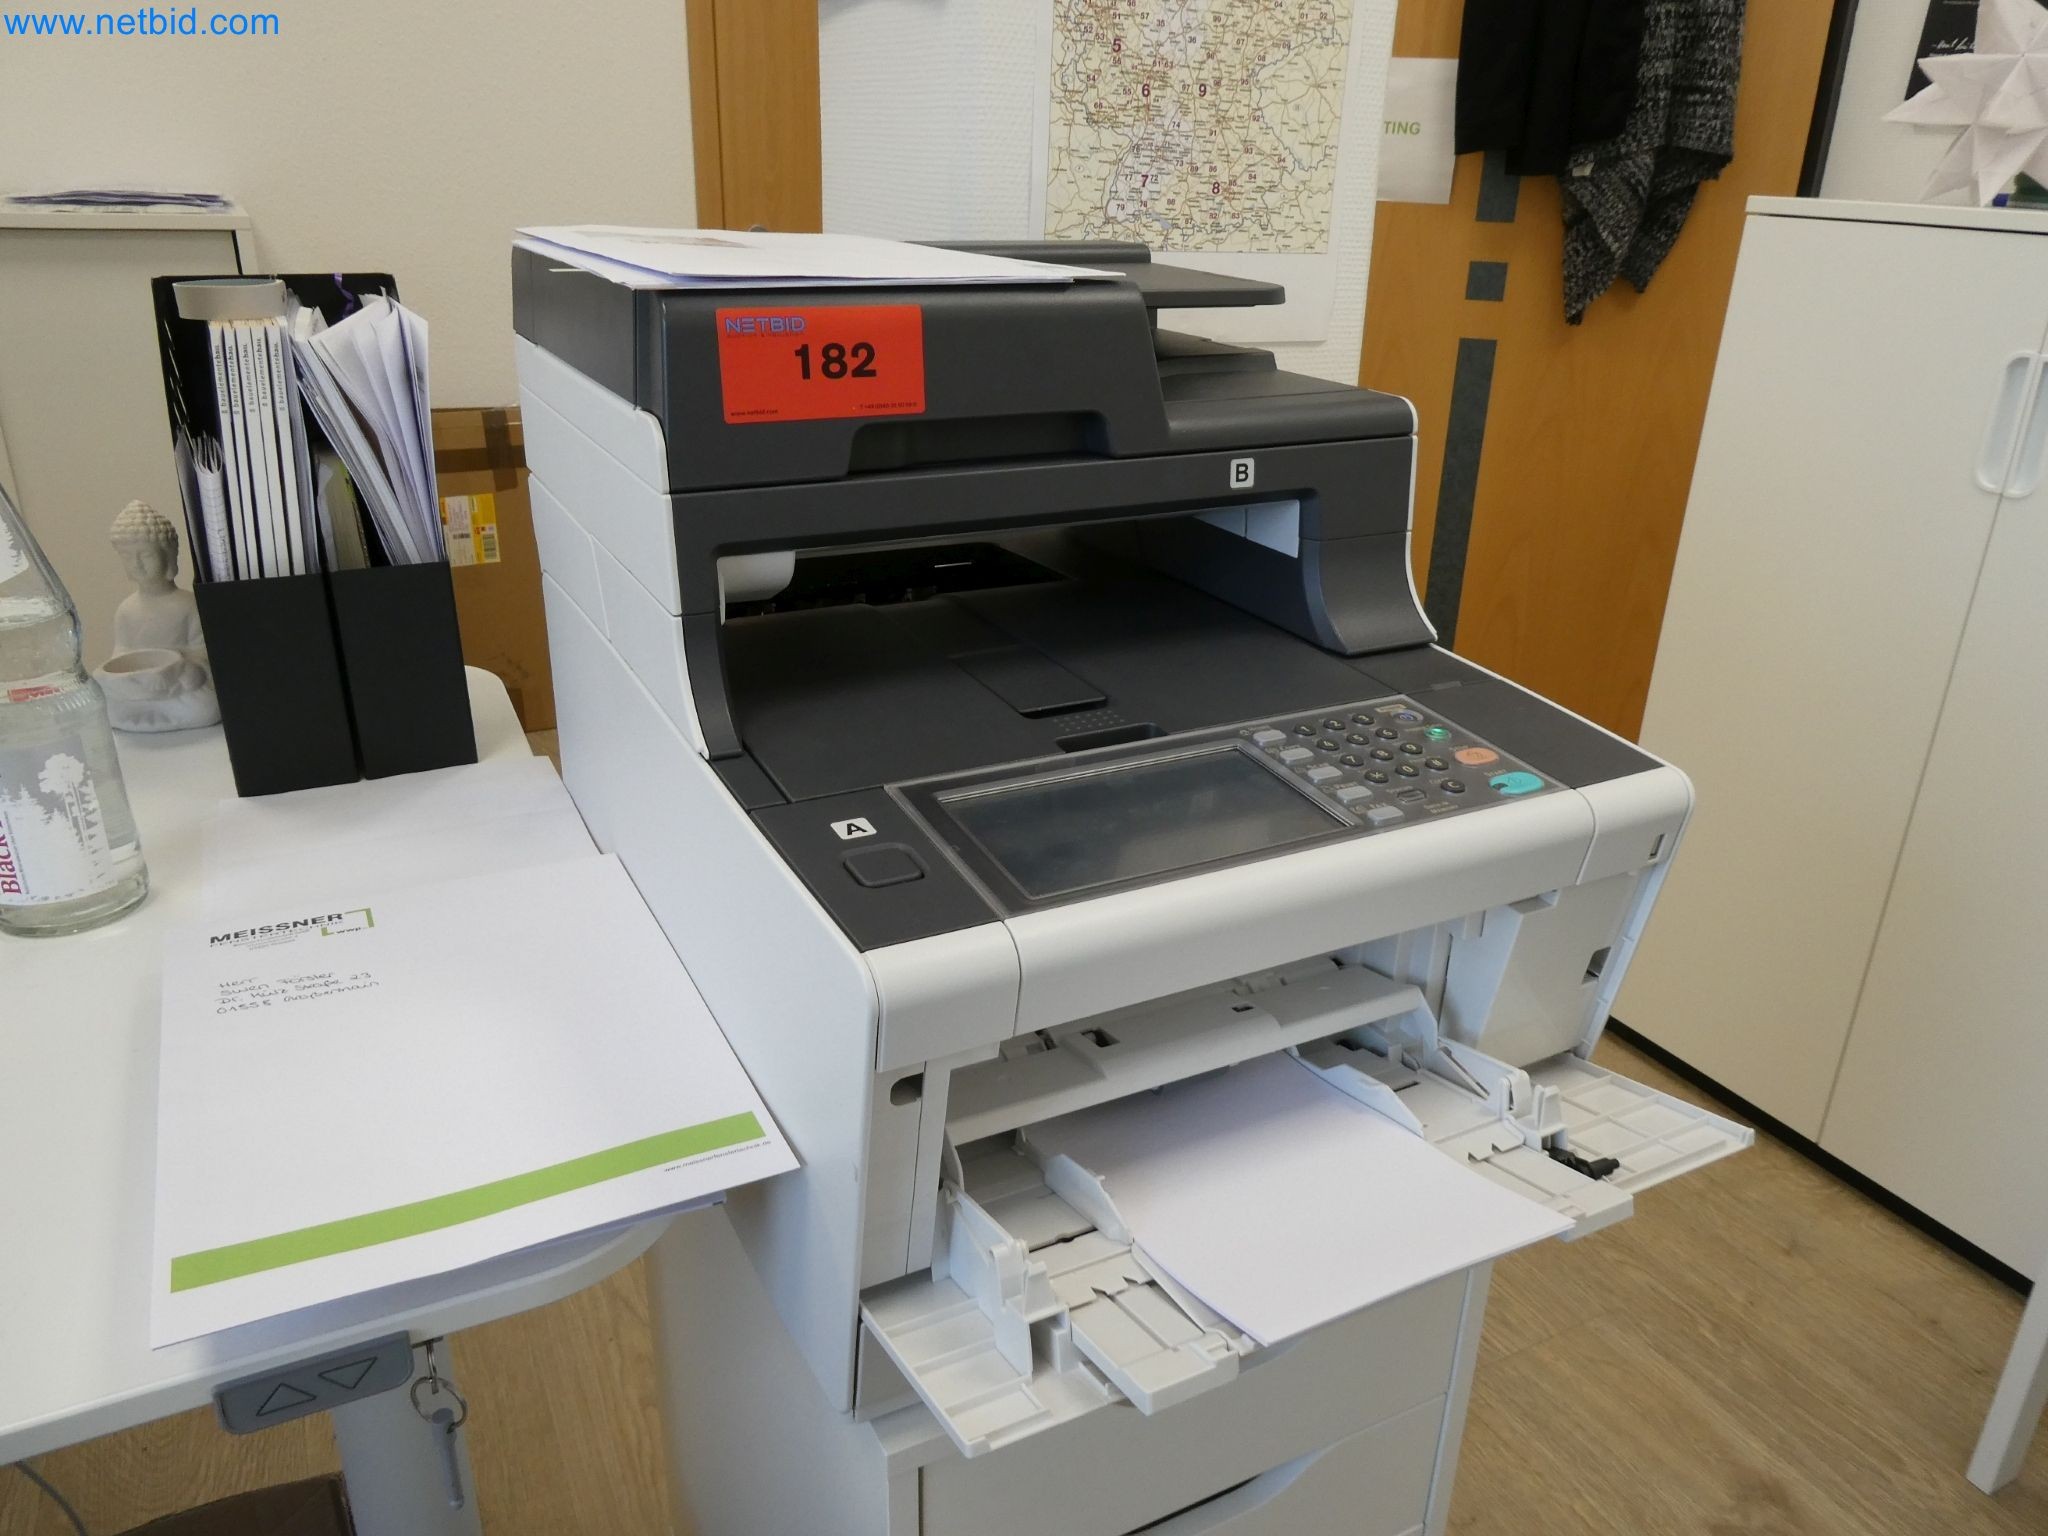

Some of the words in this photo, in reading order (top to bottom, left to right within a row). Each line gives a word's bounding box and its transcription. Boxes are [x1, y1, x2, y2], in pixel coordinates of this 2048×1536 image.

[1140, 12, 1150, 20] 57
[1083, 25, 1093, 34] 52
[1112, 38, 1122, 53] 5
[1086, 74, 1096, 83] 54
[1141, 83, 1151, 98] 6
[1199, 83, 1207, 97] 9
[1172, 121, 1181, 129] 74
[1383, 120, 1421, 136] TING
[1141, 174, 1149, 188] 7
[1212, 182, 1220, 195] 8
[724, 316, 806, 334] NETBID
[794, 342, 877, 380] 182
[1235, 463, 1249, 483] B
[846, 822, 868, 836] A
[209, 913, 344, 944] MEISSNER
